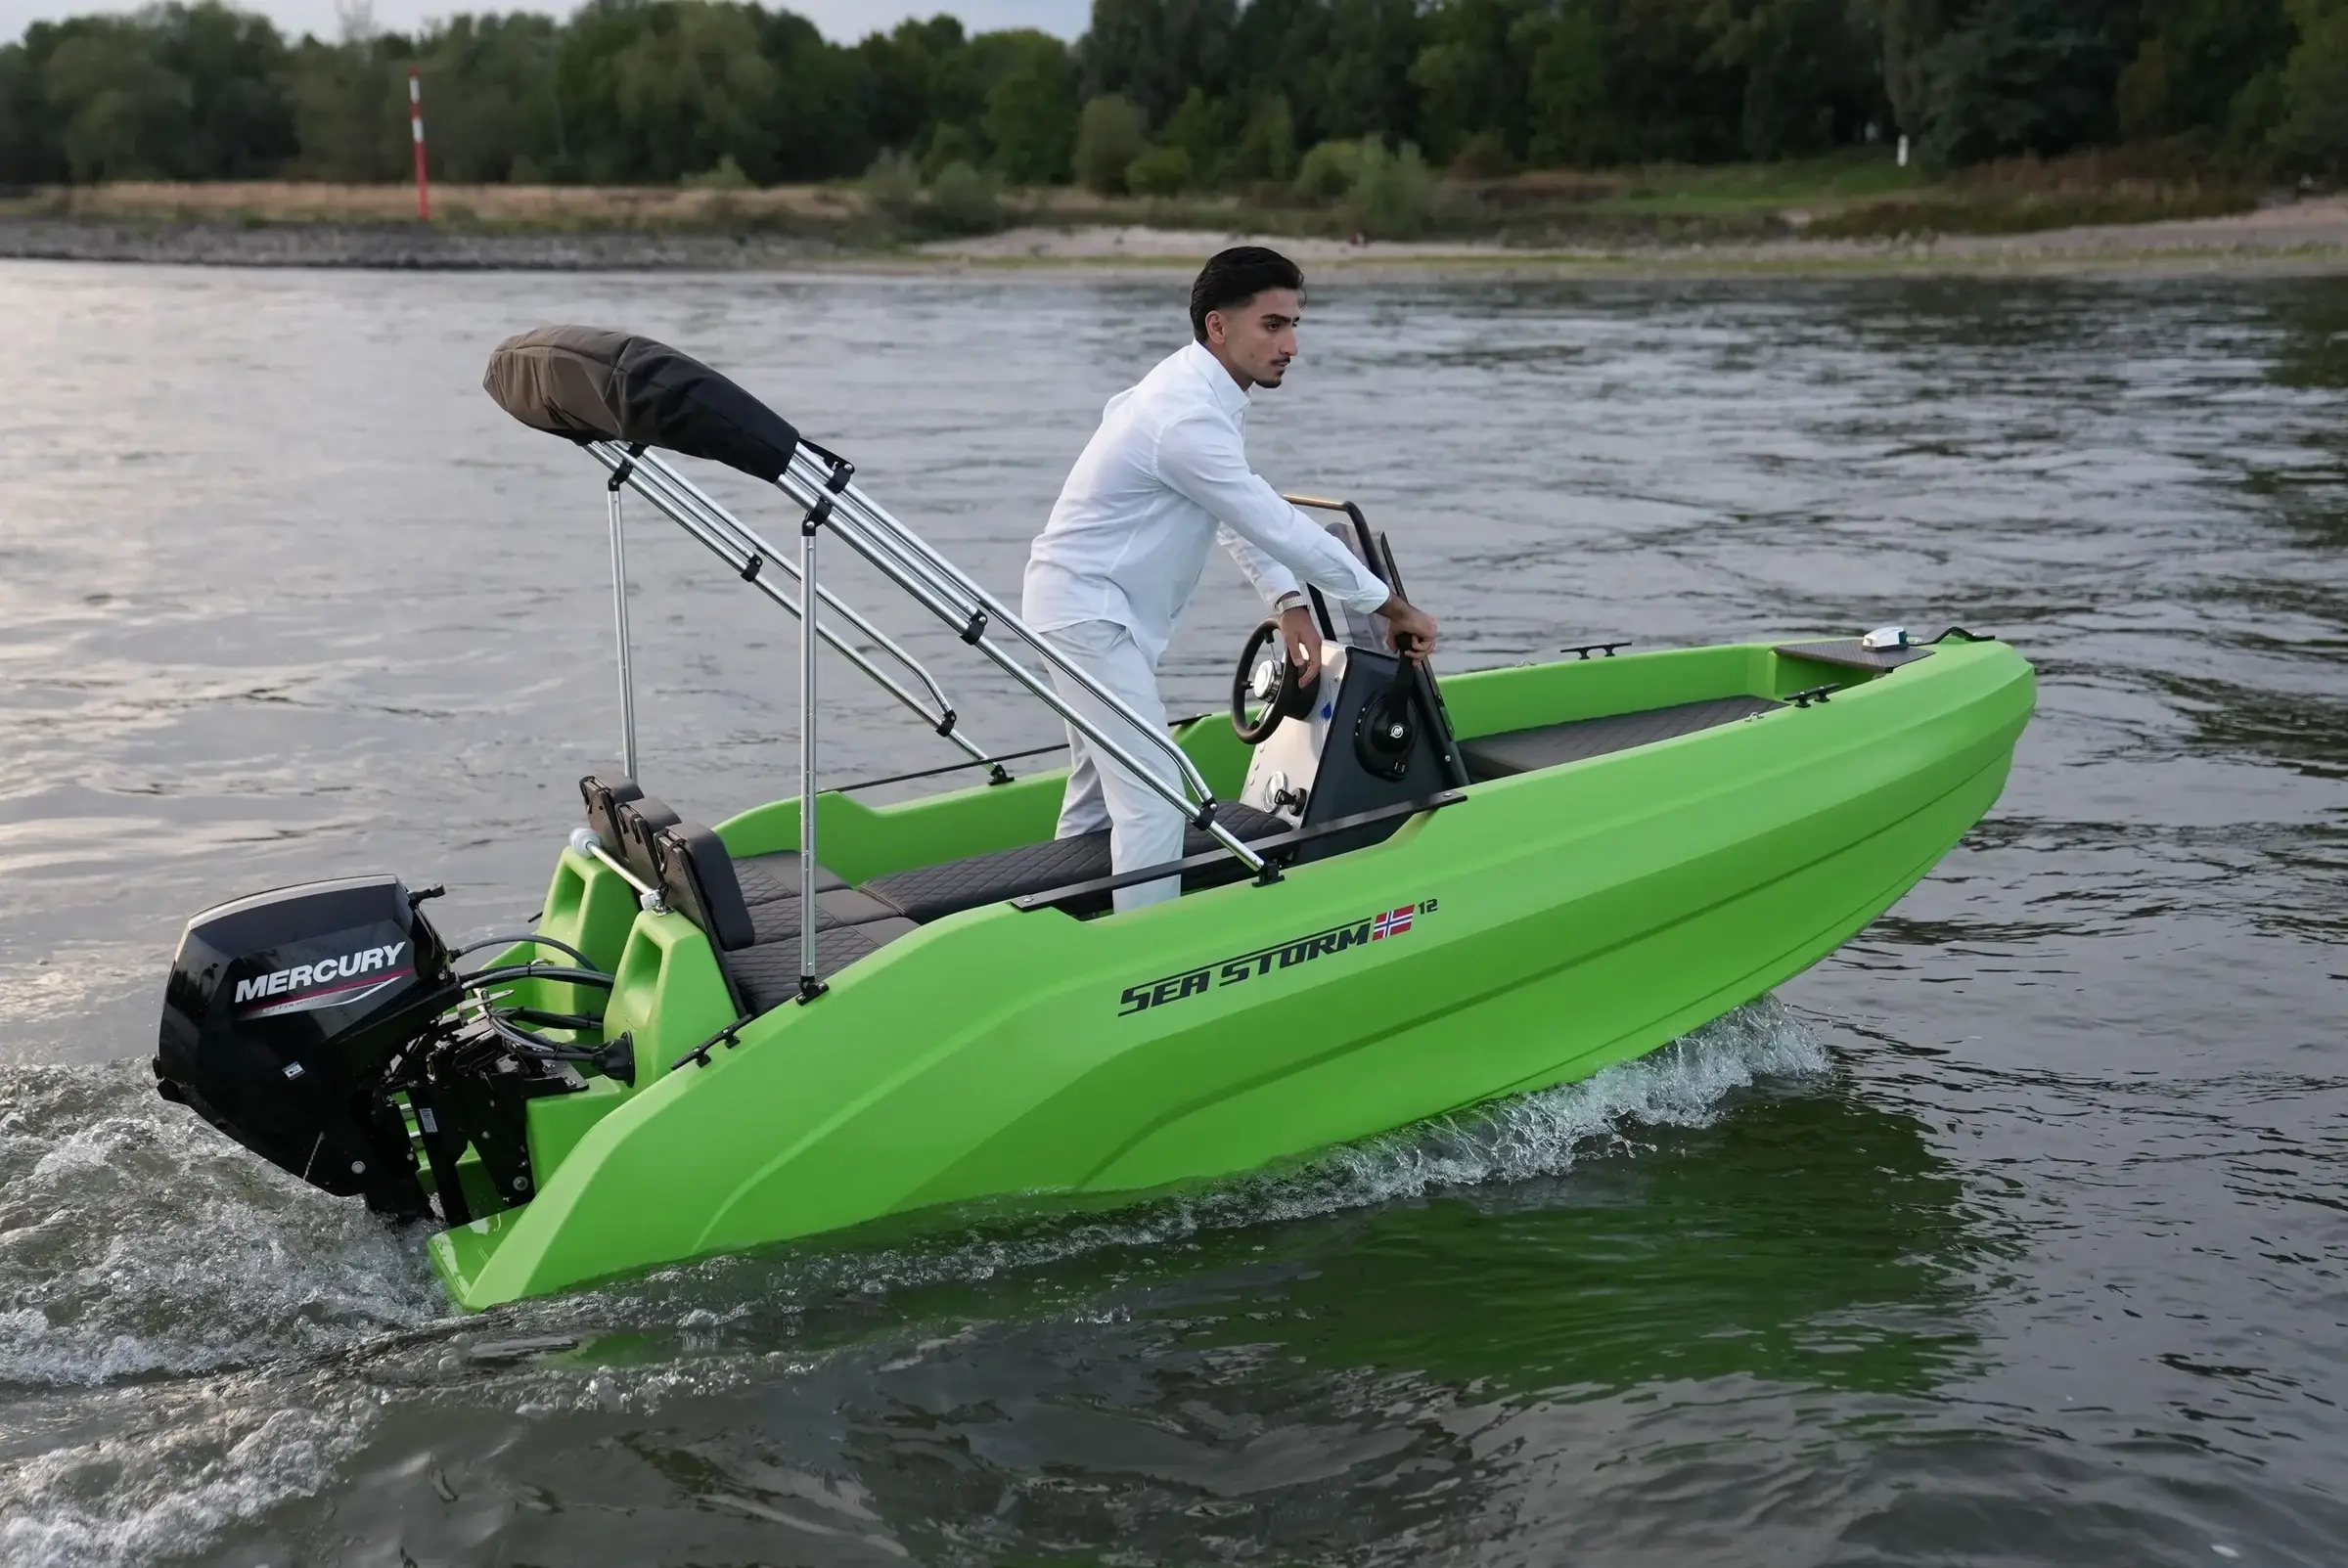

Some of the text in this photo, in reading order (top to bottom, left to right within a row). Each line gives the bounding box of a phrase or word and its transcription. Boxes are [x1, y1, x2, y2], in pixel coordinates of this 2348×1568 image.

[235, 941, 406, 1003] MERCURY
[1117, 898, 1439, 1016] SEA STORM 12
